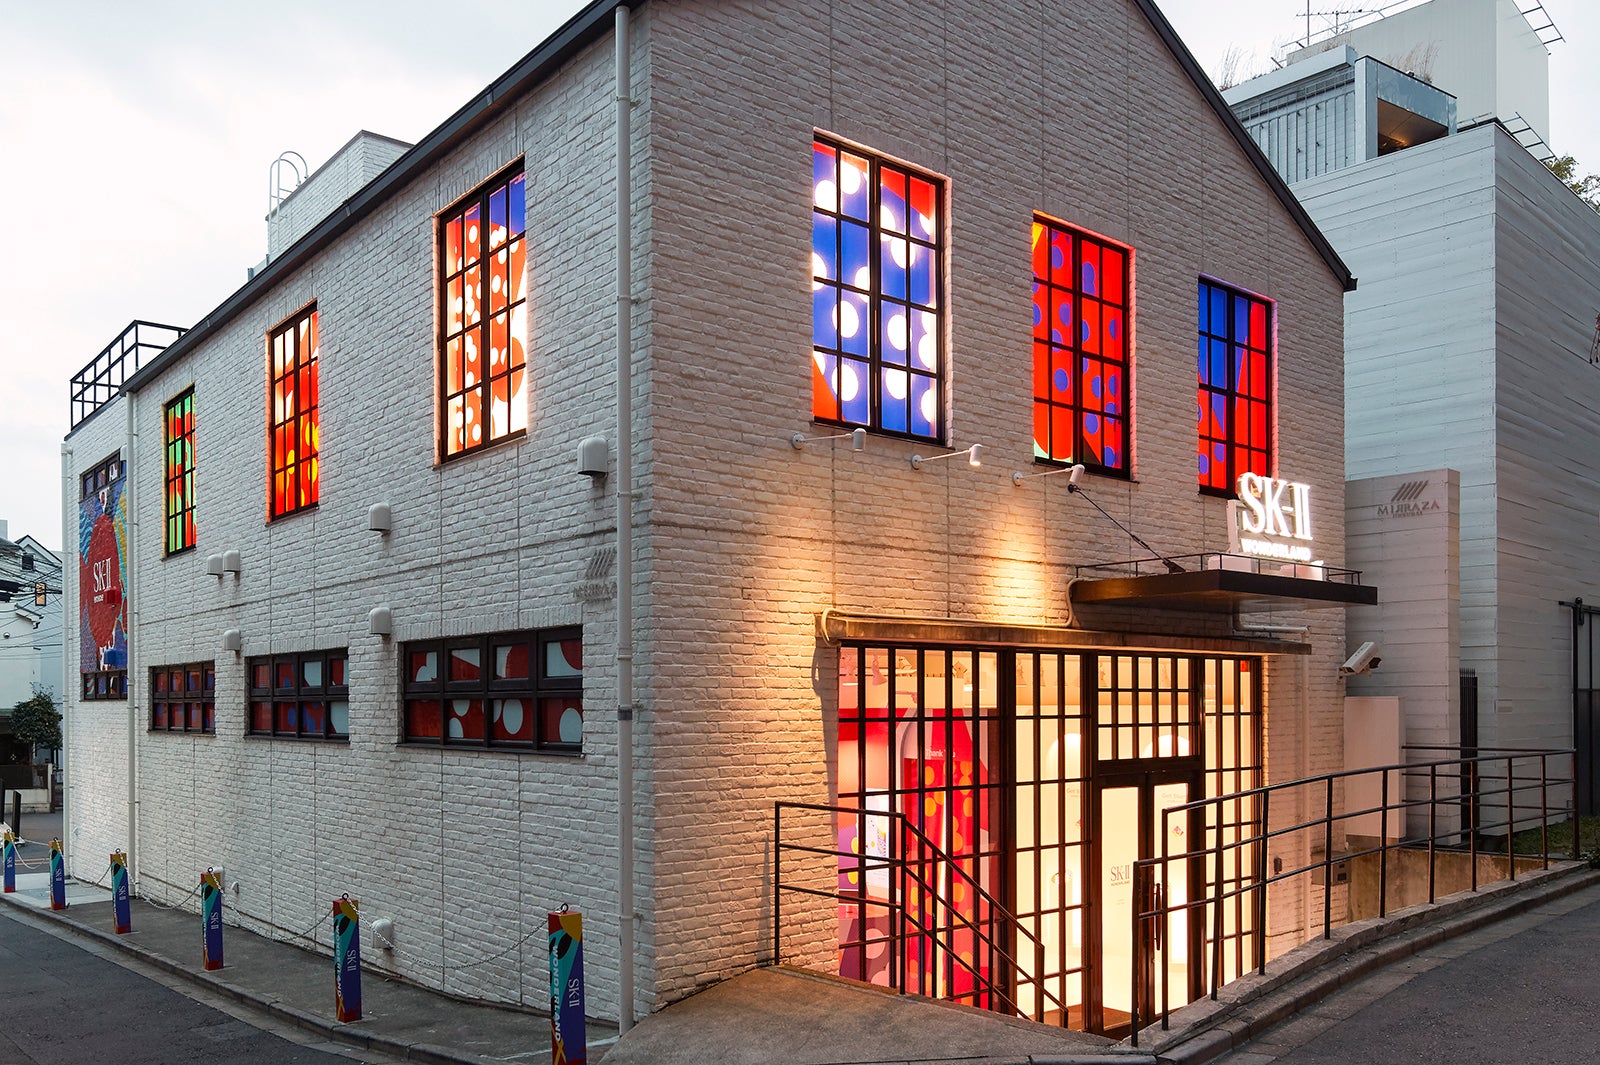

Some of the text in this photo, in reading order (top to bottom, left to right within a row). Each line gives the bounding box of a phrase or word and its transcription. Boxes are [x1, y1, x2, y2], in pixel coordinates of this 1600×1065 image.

[1239, 472, 1313, 540] SK-II
[1240, 538, 1312, 561] WONDERLAND
[94, 558, 111, 592] SK-II
[1110, 865, 1130, 881] SK-II
[347, 949, 357, 972] SK-II
[551, 945, 562, 1043] WONDERLAND
[567, 978, 580, 1008] SK-II
